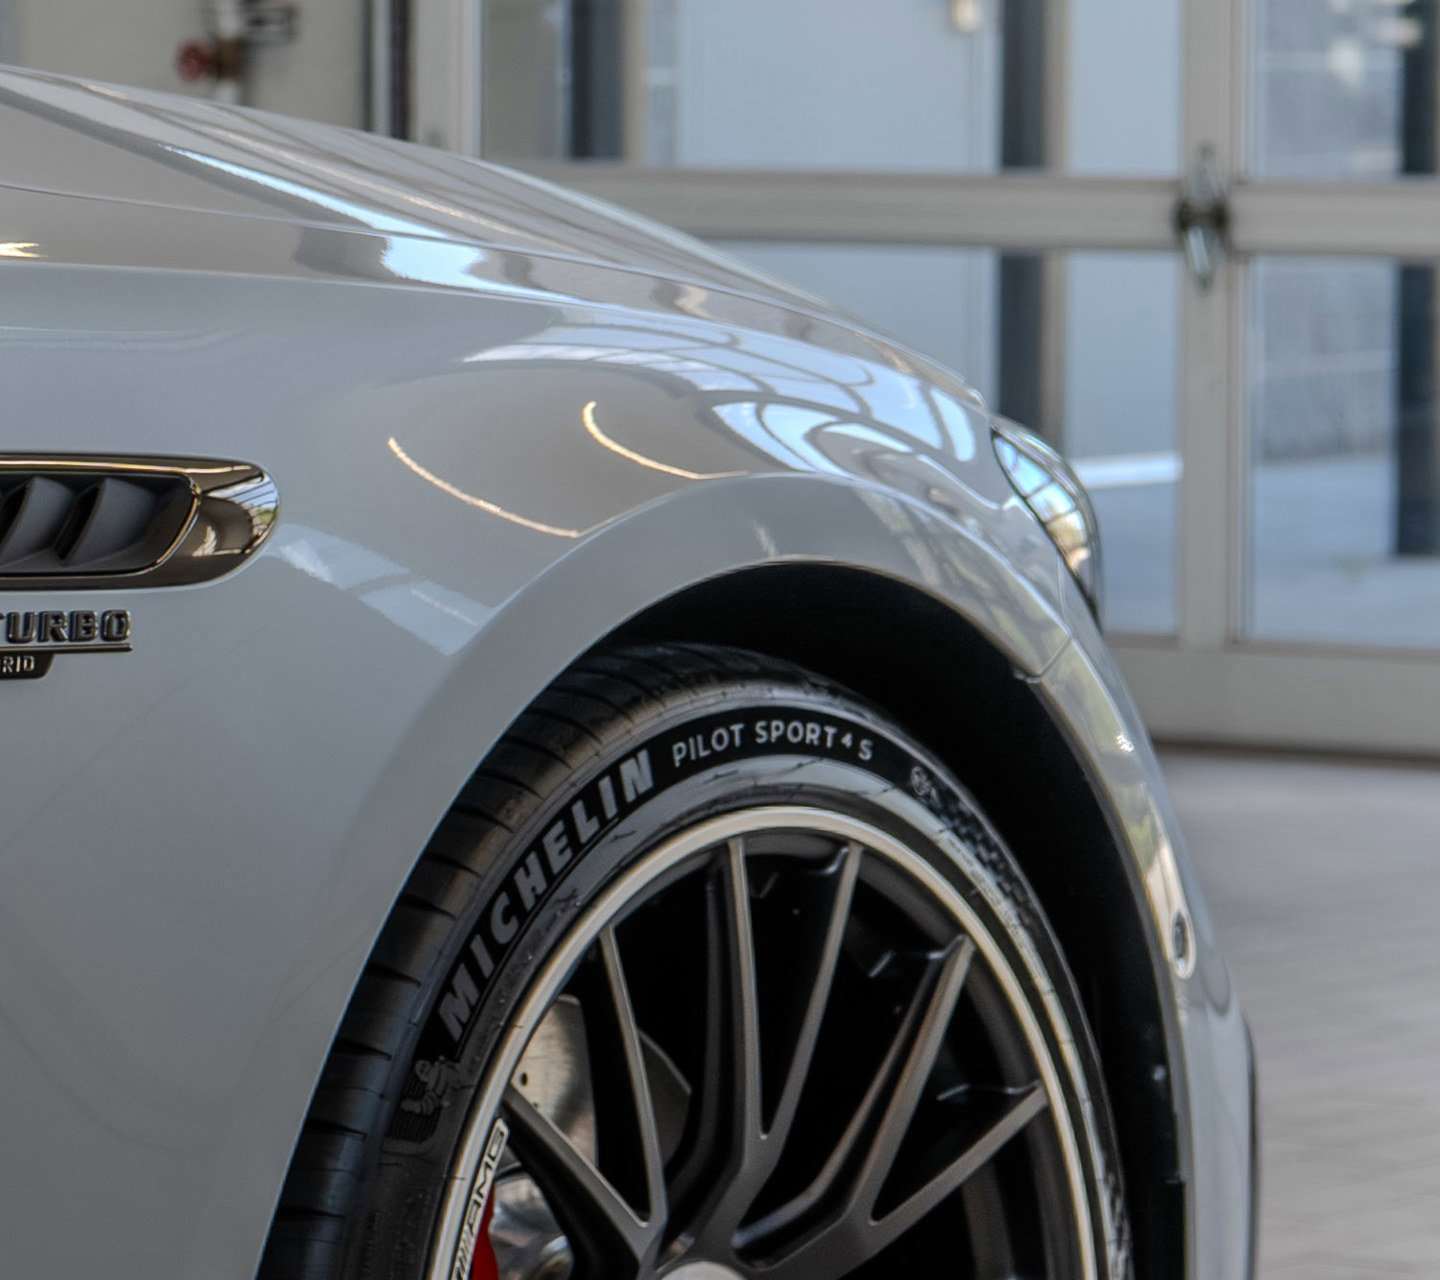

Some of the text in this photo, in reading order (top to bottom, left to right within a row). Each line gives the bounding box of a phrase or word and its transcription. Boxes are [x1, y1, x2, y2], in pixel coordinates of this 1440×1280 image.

[435, 748, 654, 1043] MICHELIN
[671, 722, 746, 769] PILOT
[754, 719, 838, 752] SPORT
